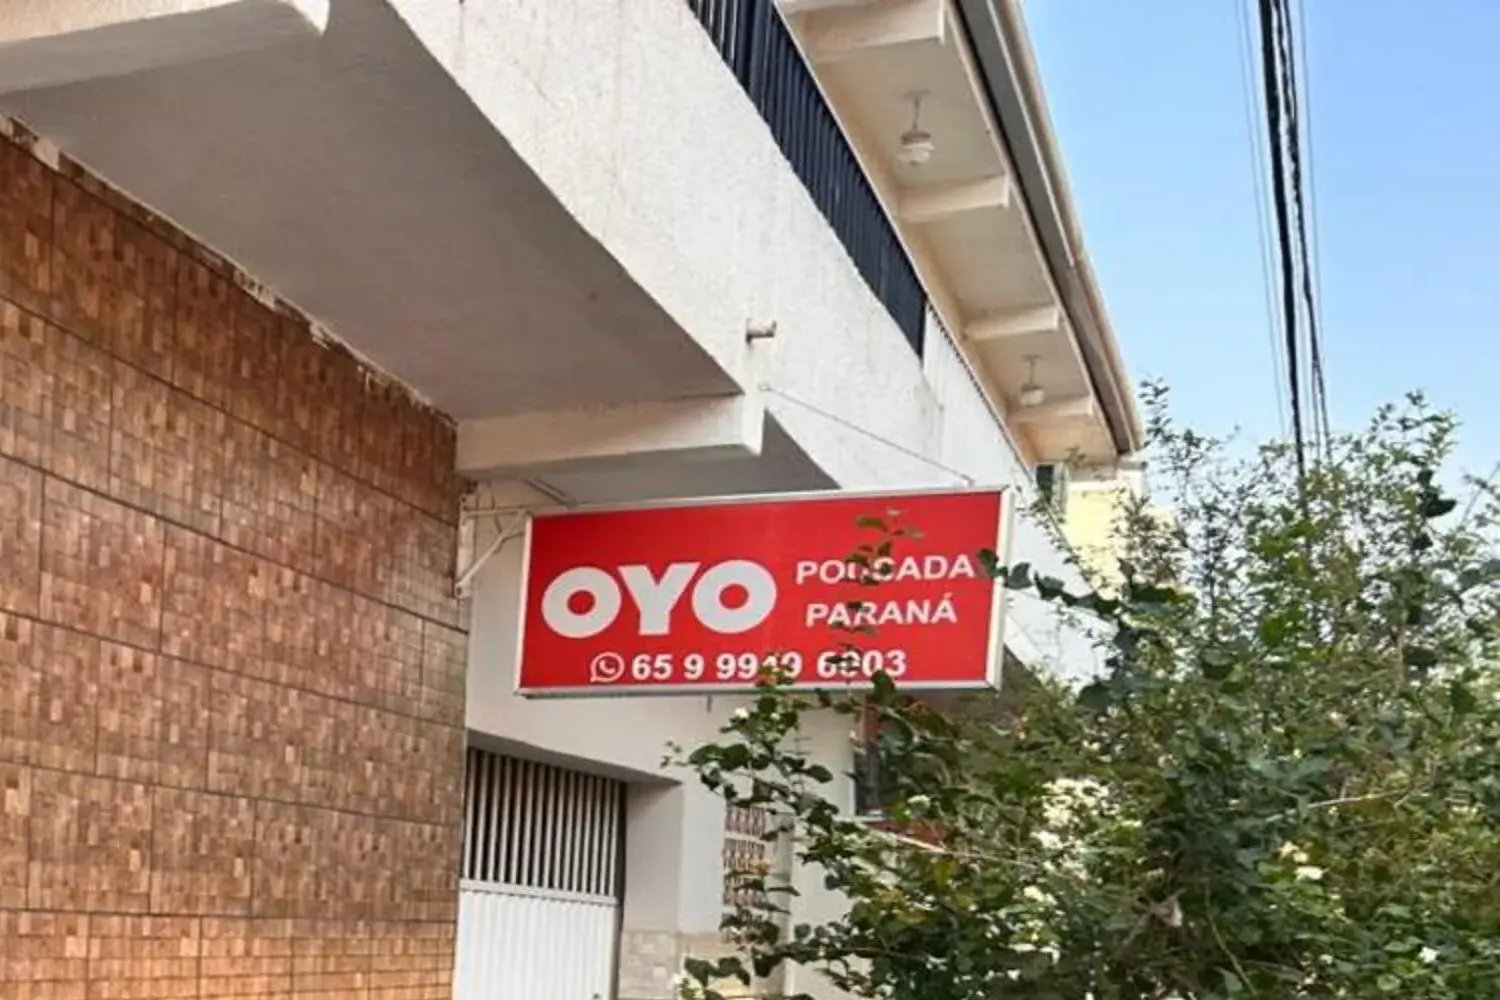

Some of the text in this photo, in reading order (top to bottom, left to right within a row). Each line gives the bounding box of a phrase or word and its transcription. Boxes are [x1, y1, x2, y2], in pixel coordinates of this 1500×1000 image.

[541, 559, 778, 639] OYO
[805, 592, 958, 629] PARANÁ
[631, 653, 673, 680] 65
[683, 653, 705, 680] 9
